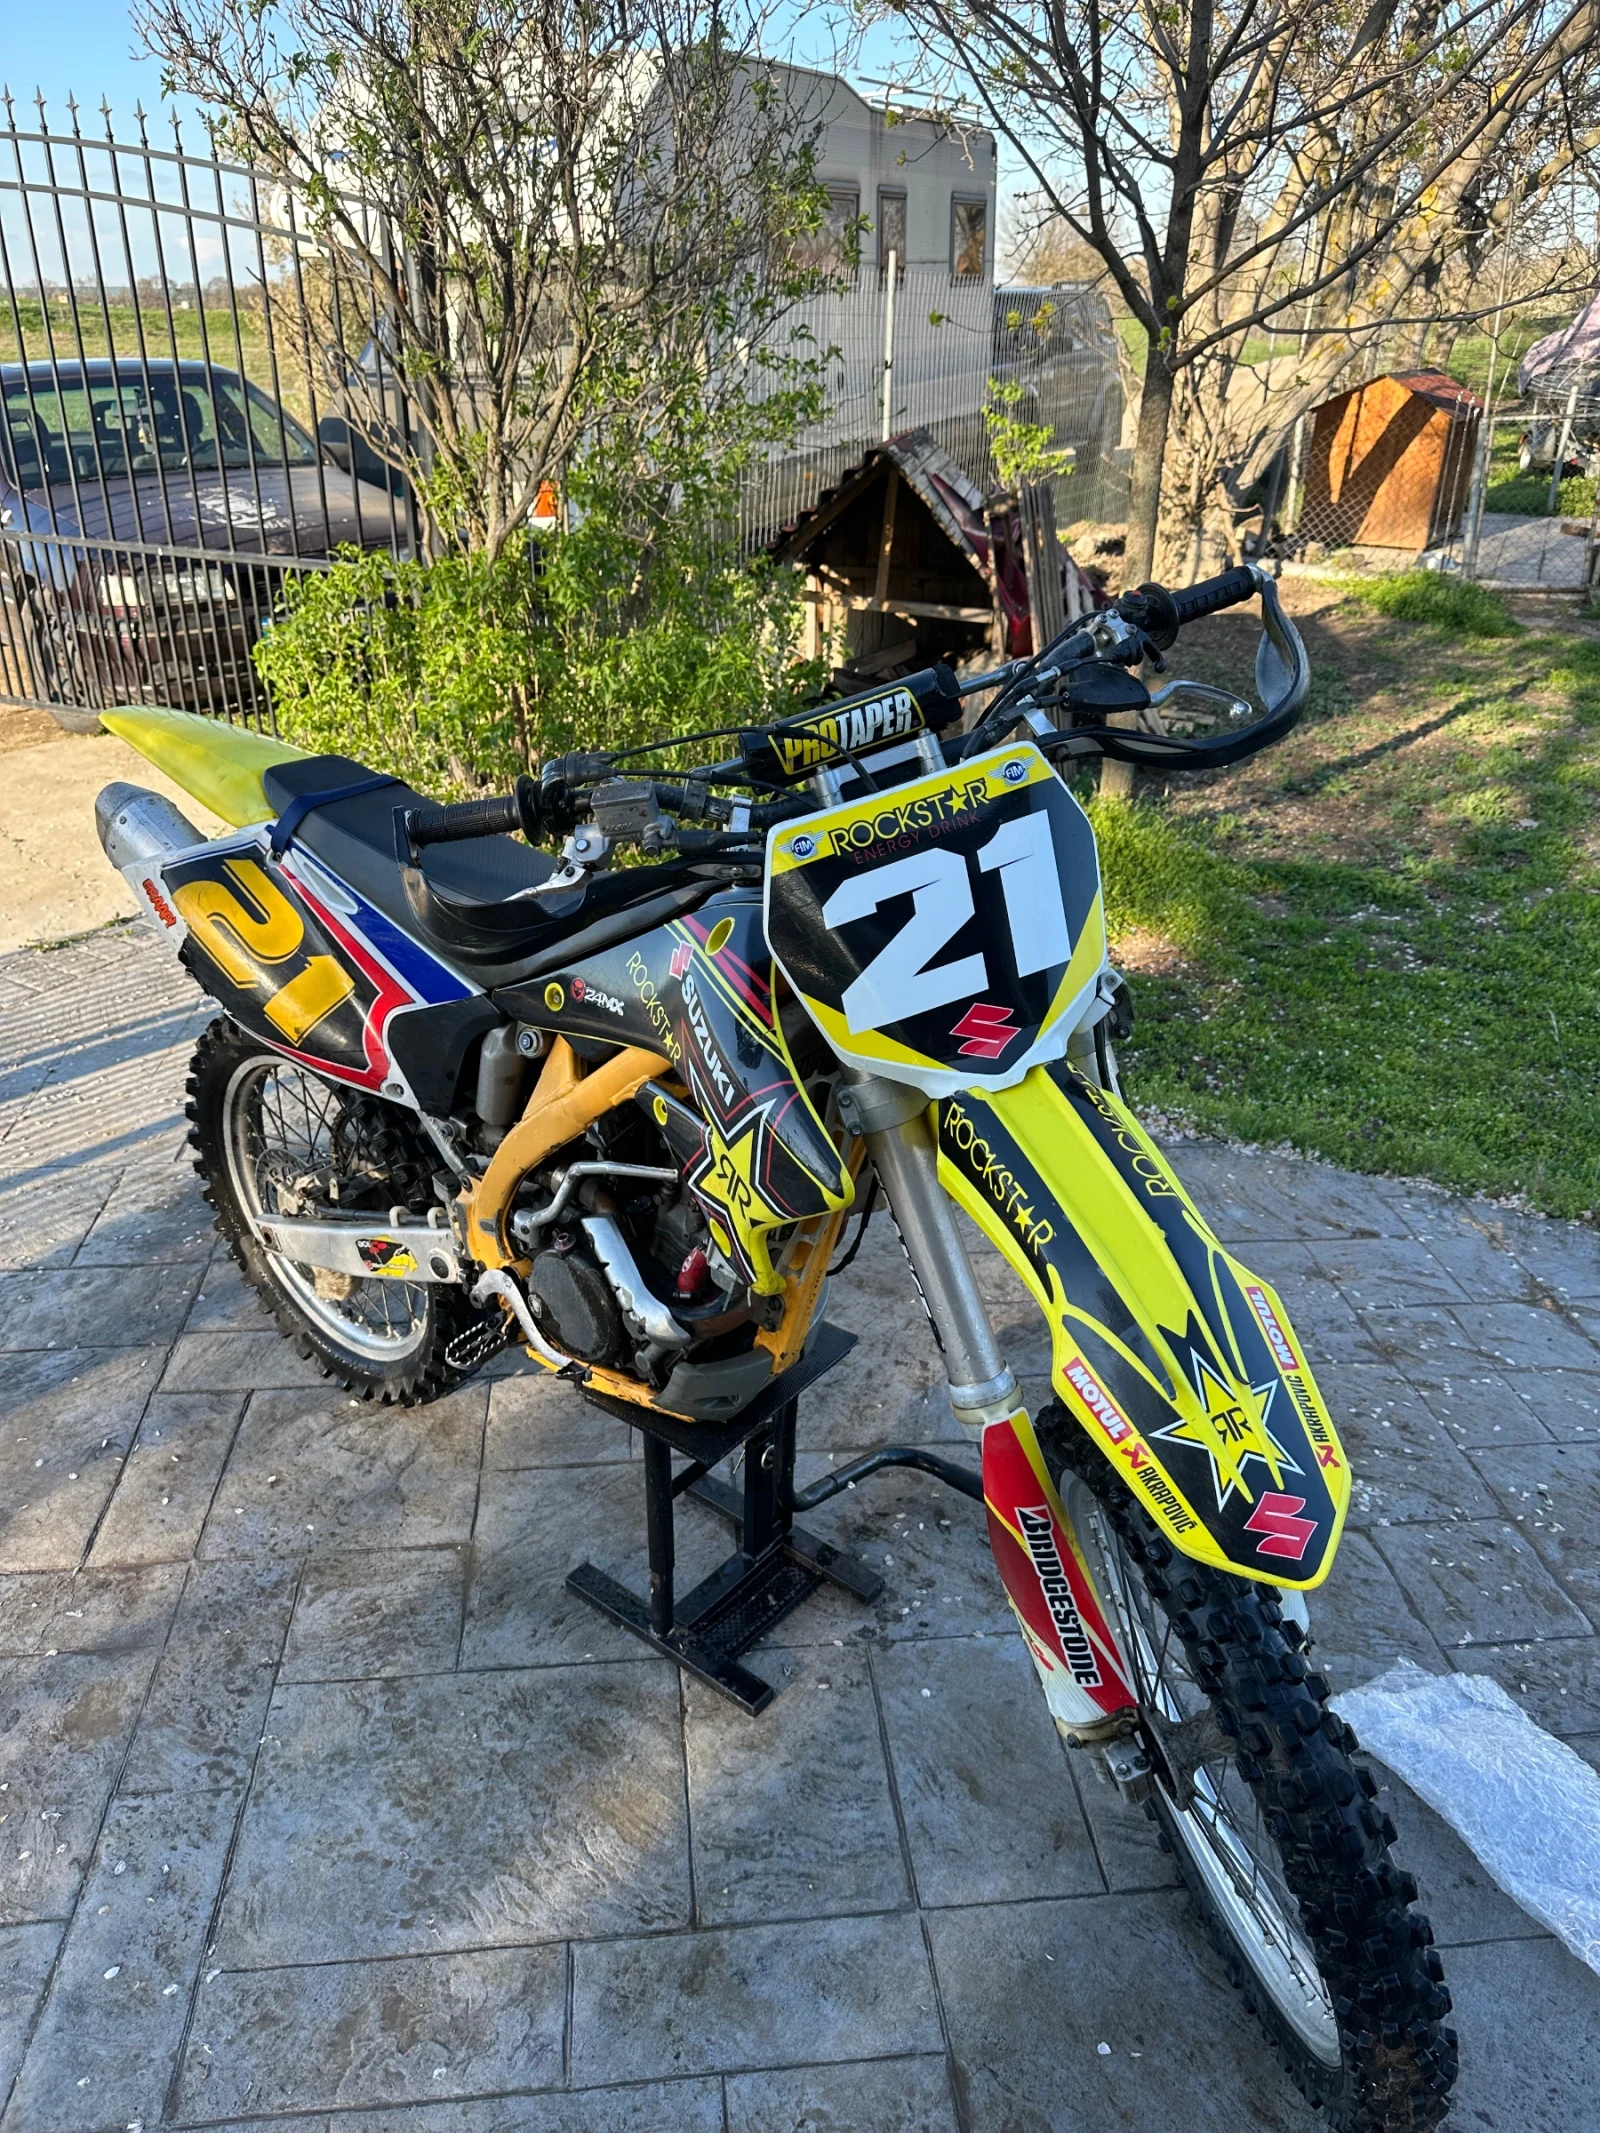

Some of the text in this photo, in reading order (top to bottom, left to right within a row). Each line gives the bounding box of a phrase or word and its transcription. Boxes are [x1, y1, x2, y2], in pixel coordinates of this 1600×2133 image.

[784, 691, 912, 768] PROTAPER
[1004, 765, 1025, 781] FIM
[794, 840, 814, 855] FIM
[854, 812, 980, 865] ENERGY DRINK
[172, 858, 355, 1047] 21
[822, 809, 1071, 1035] 21
[682, 974, 735, 1107] SUZUKI
[1250, 1290, 1295, 1366] MOTUL
[1066, 1366, 1126, 1439] MOTUL
[1015, 1505, 1102, 1687] BRIDGESTONE
